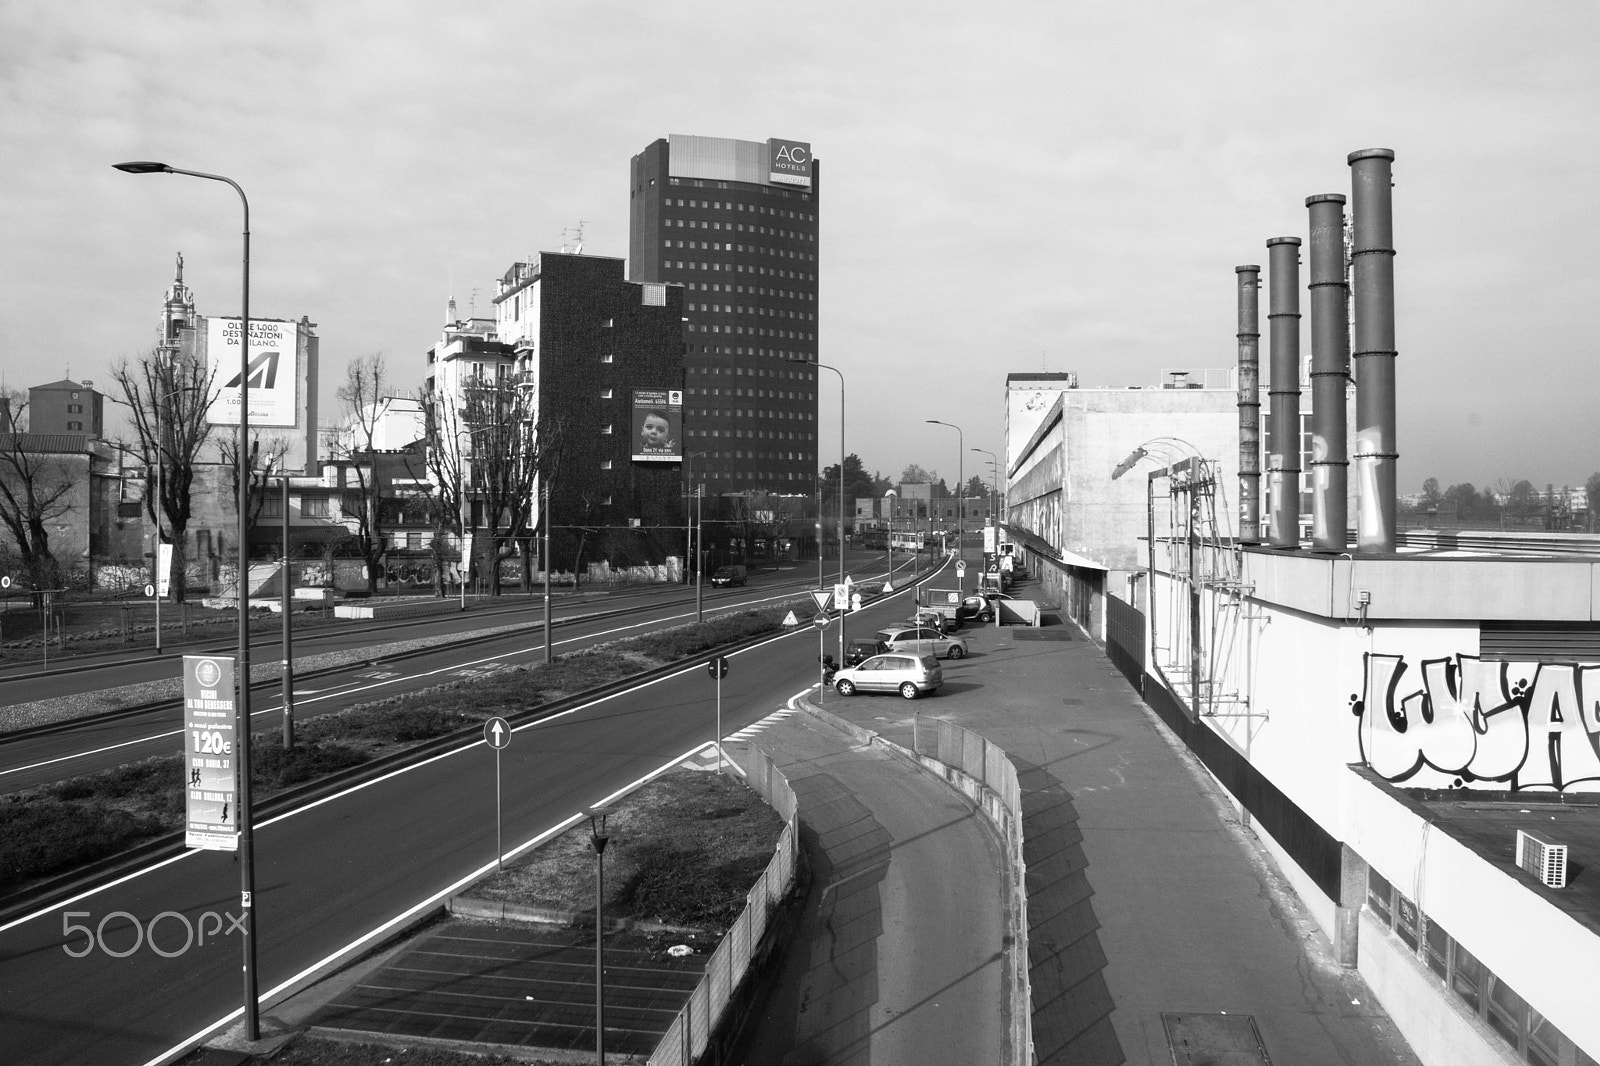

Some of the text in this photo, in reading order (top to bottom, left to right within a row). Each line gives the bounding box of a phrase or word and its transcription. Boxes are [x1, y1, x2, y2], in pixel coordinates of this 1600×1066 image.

[776, 145, 806, 163] AC
[775, 162, 806, 171] HOTELS
[227, 322, 255, 331] OLTE
[222, 330, 283, 339] DESTNAZIONI
[192, 731, 232, 755] 120€
